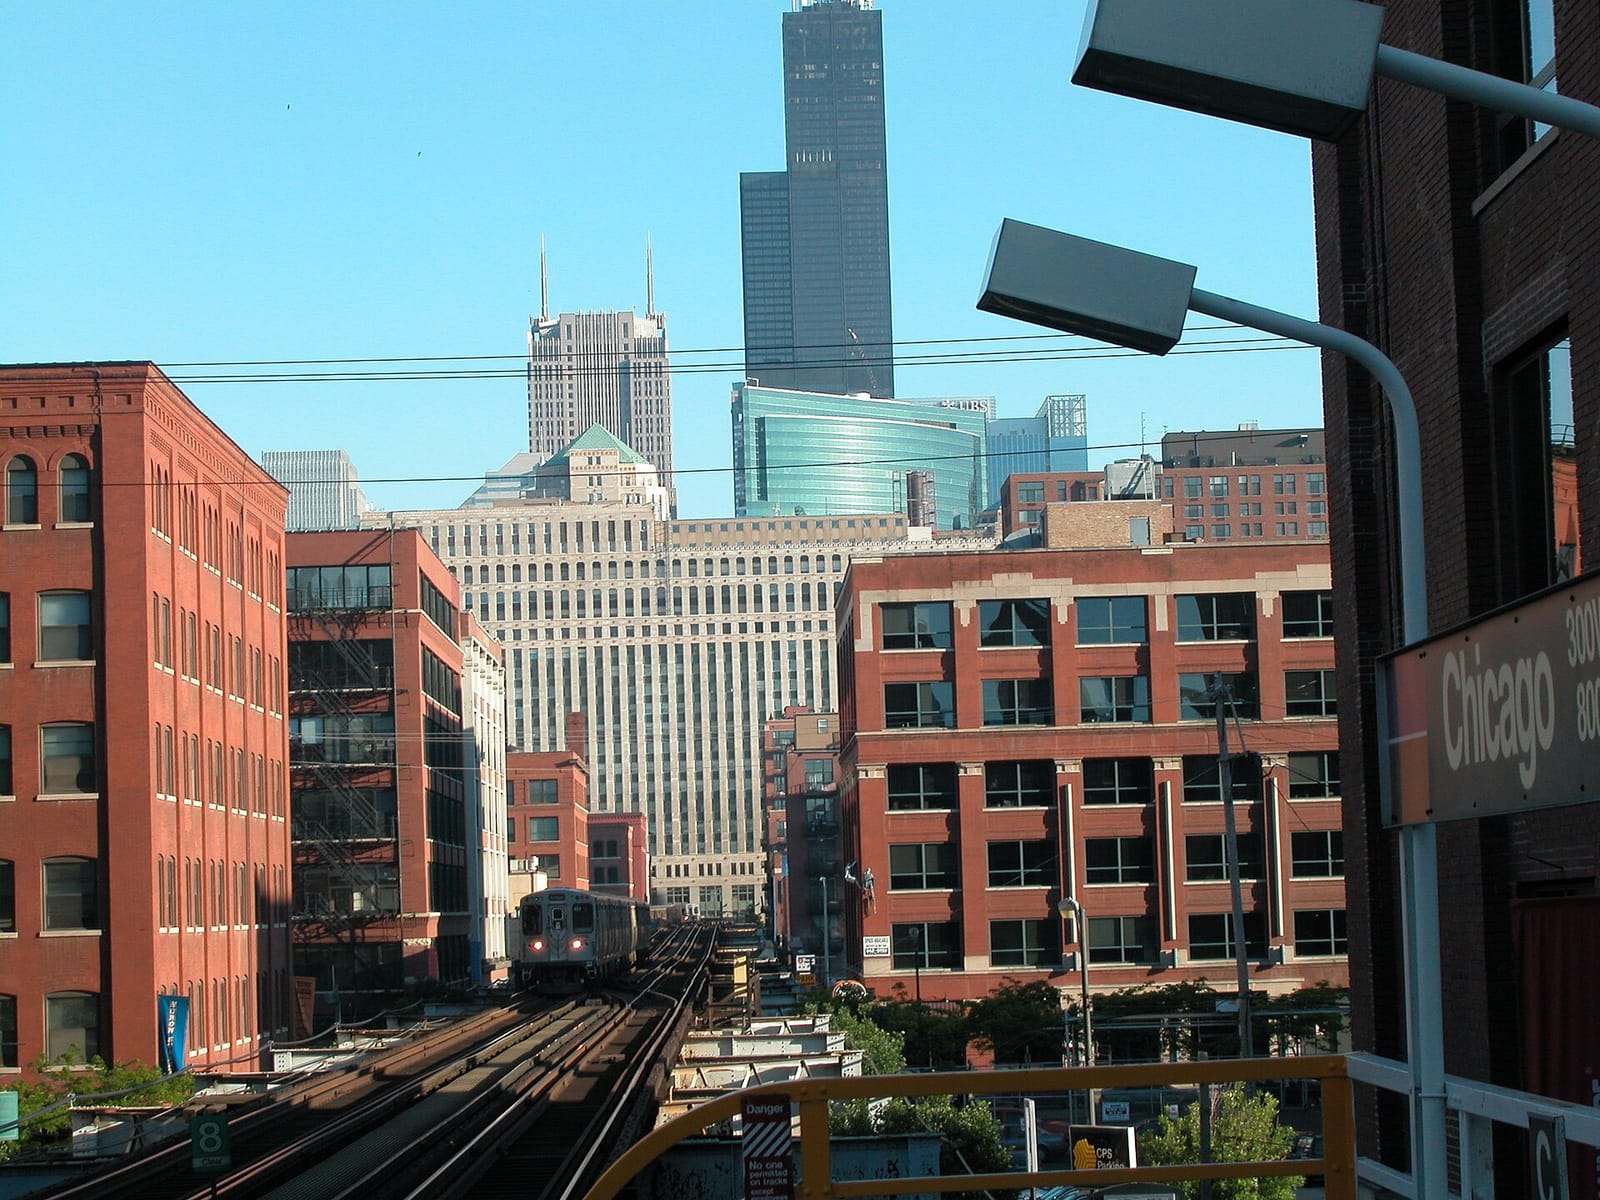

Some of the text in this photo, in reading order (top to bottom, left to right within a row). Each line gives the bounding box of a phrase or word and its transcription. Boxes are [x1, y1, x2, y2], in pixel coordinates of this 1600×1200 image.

[959, 400, 988, 412] UBS
[1442, 643, 1555, 791] Chicago
[746, 1104, 784, 1115] Danger
[199, 1121, 223, 1153] 8
[1096, 1147, 1113, 1159] CPS
[749, 1161, 783, 1170] No one
[1535, 1129, 1554, 1200] C
[749, 1169, 788, 1179] permitted
[763, 1177, 788, 1186] tracks
